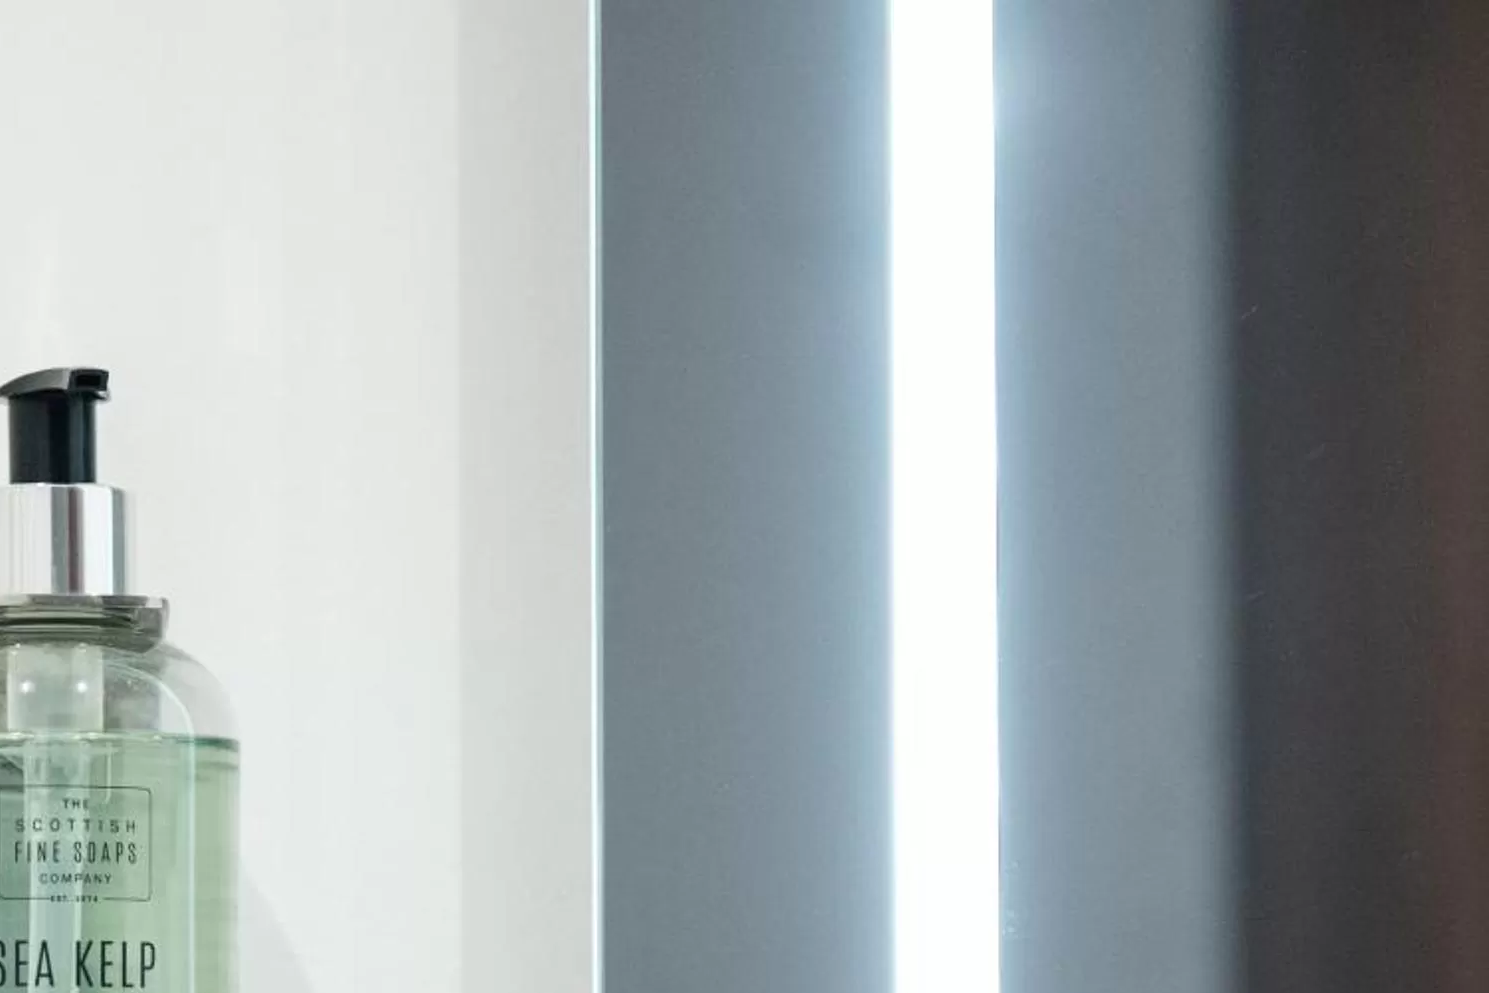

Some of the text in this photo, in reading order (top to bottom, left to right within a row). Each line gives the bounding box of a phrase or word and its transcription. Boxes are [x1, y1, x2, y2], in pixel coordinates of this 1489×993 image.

[62, 798, 89, 809] THE
[15, 818, 136, 834] SCOTTISH
[14, 841, 137, 865] FINE SOAPS
[38, 873, 112, 885] COMPANY
[75, 940, 156, 989] KELP
